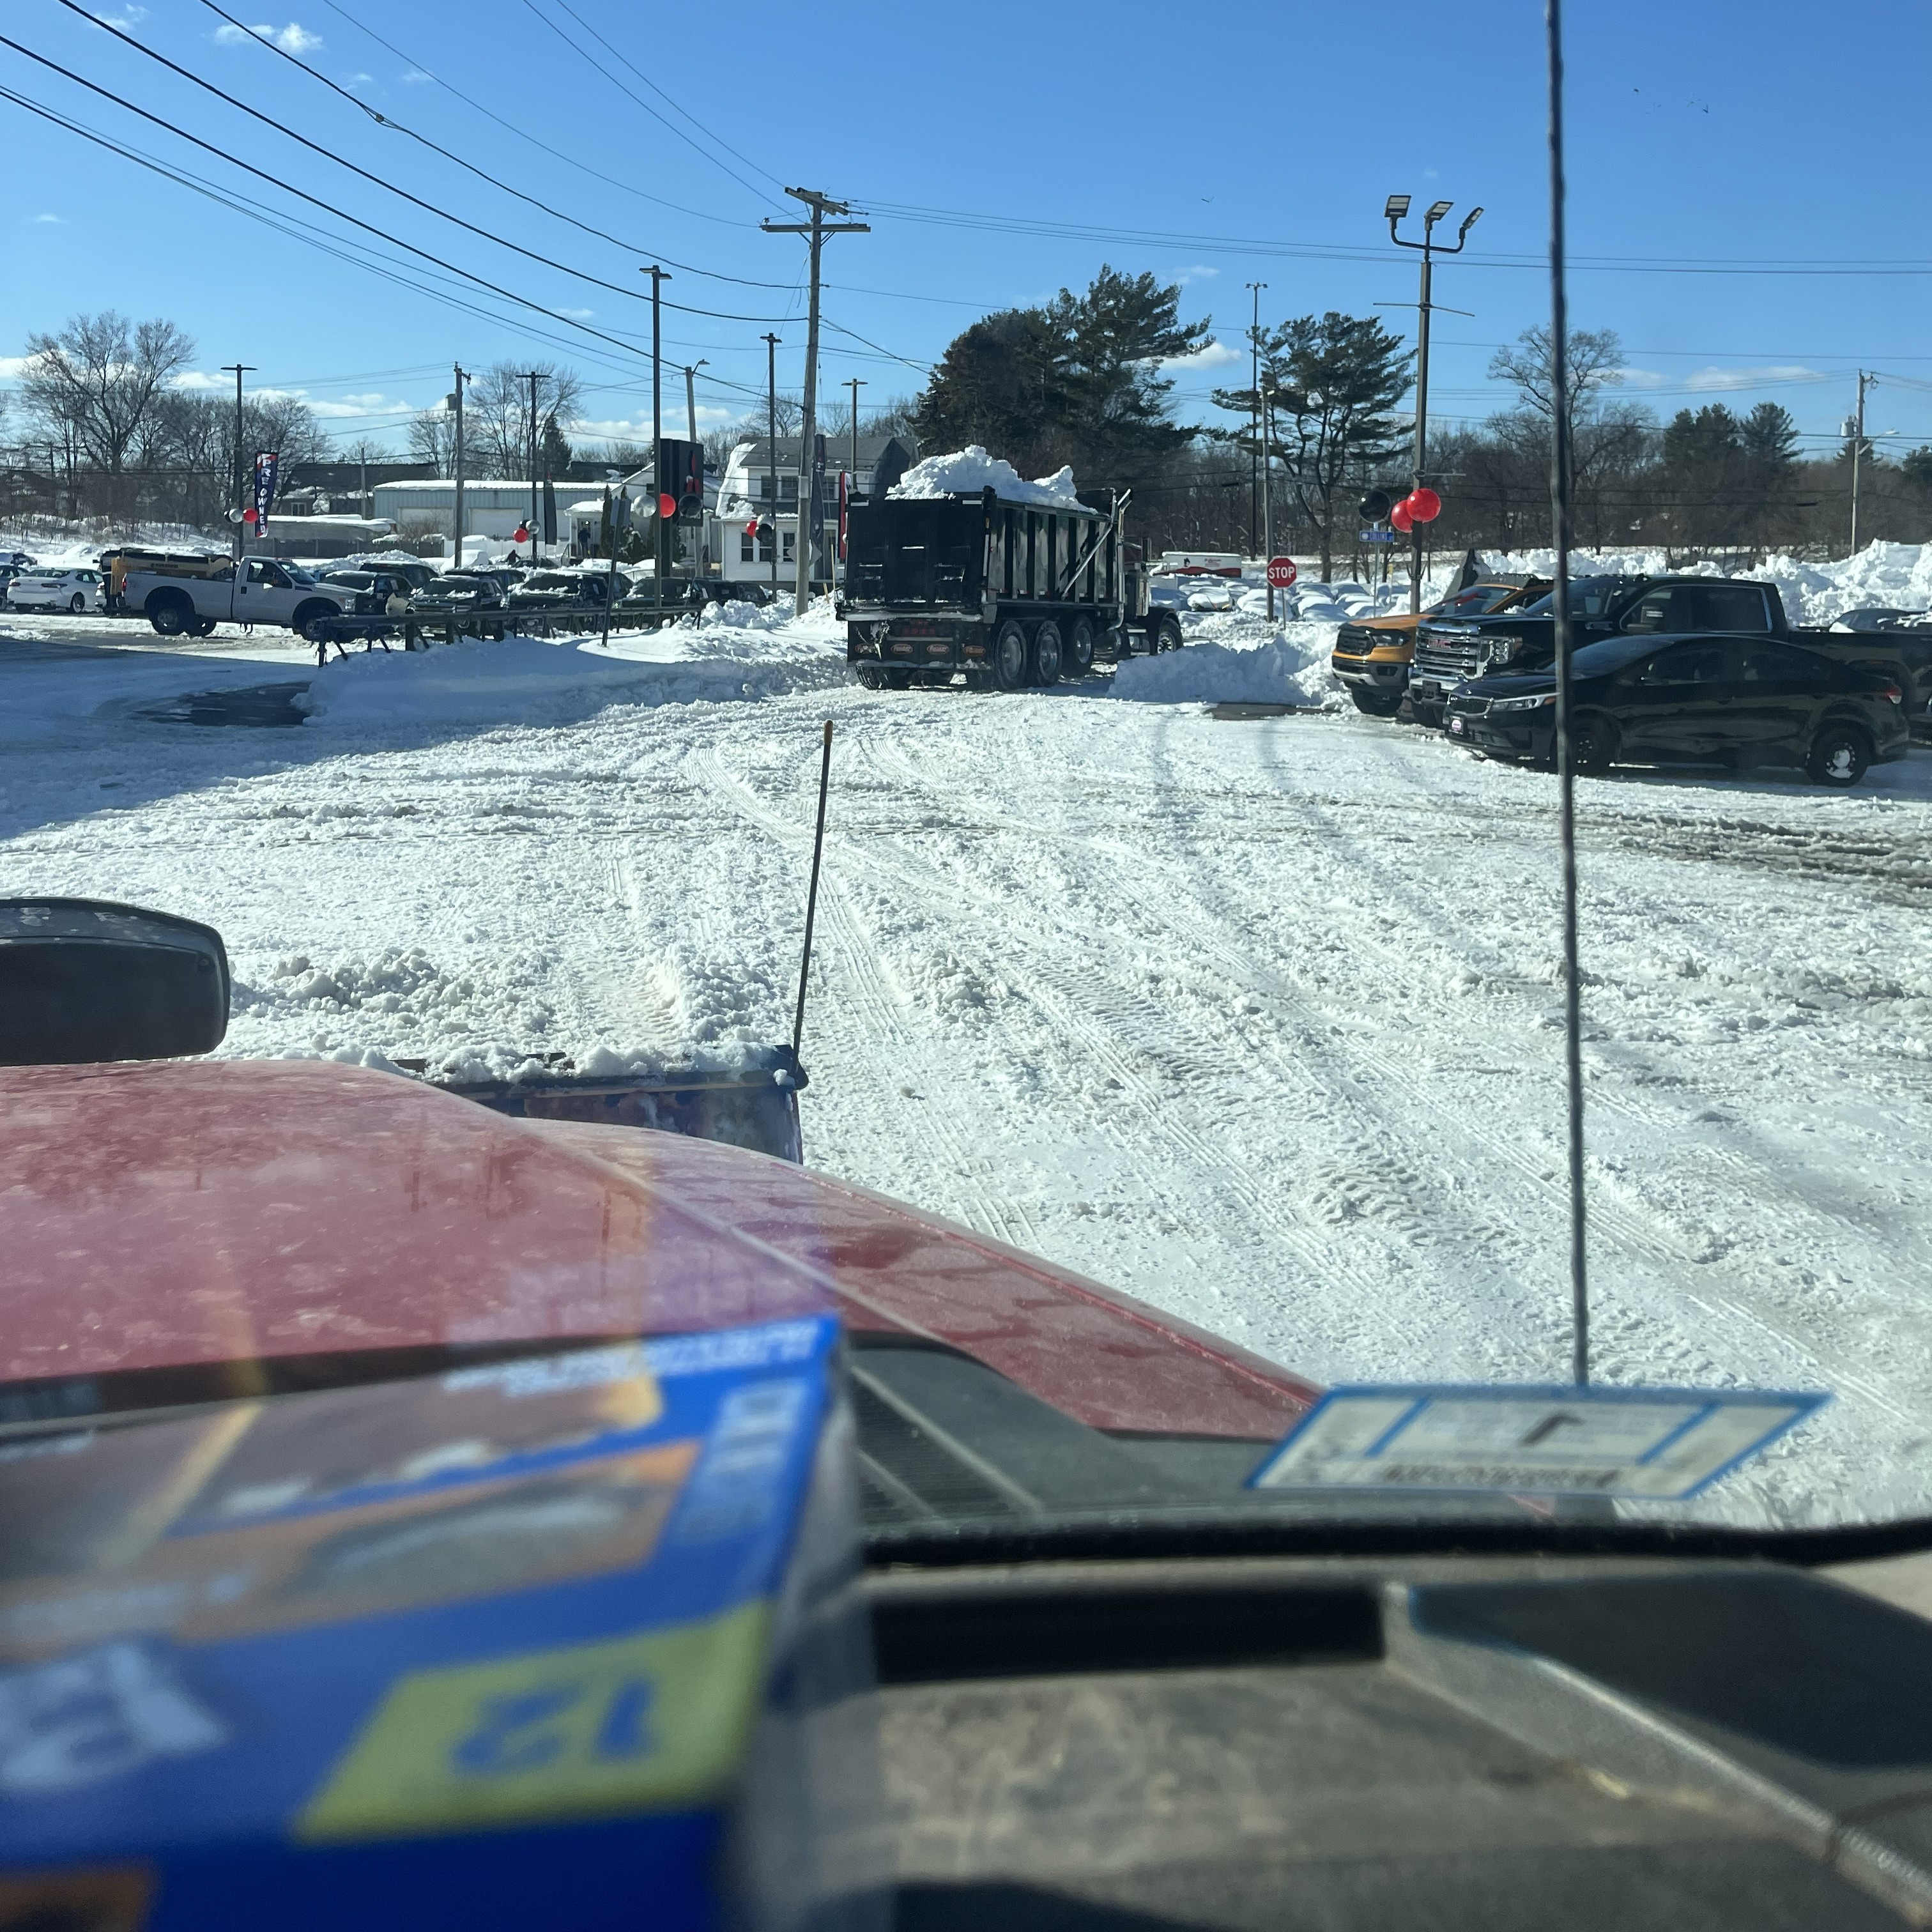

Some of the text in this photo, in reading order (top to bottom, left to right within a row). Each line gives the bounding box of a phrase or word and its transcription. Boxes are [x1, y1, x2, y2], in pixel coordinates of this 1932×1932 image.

[257, 459, 272, 534] PRE OWNED
[1268, 566, 1295, 579] STOP
[1428, 638, 1451, 650] GMC
